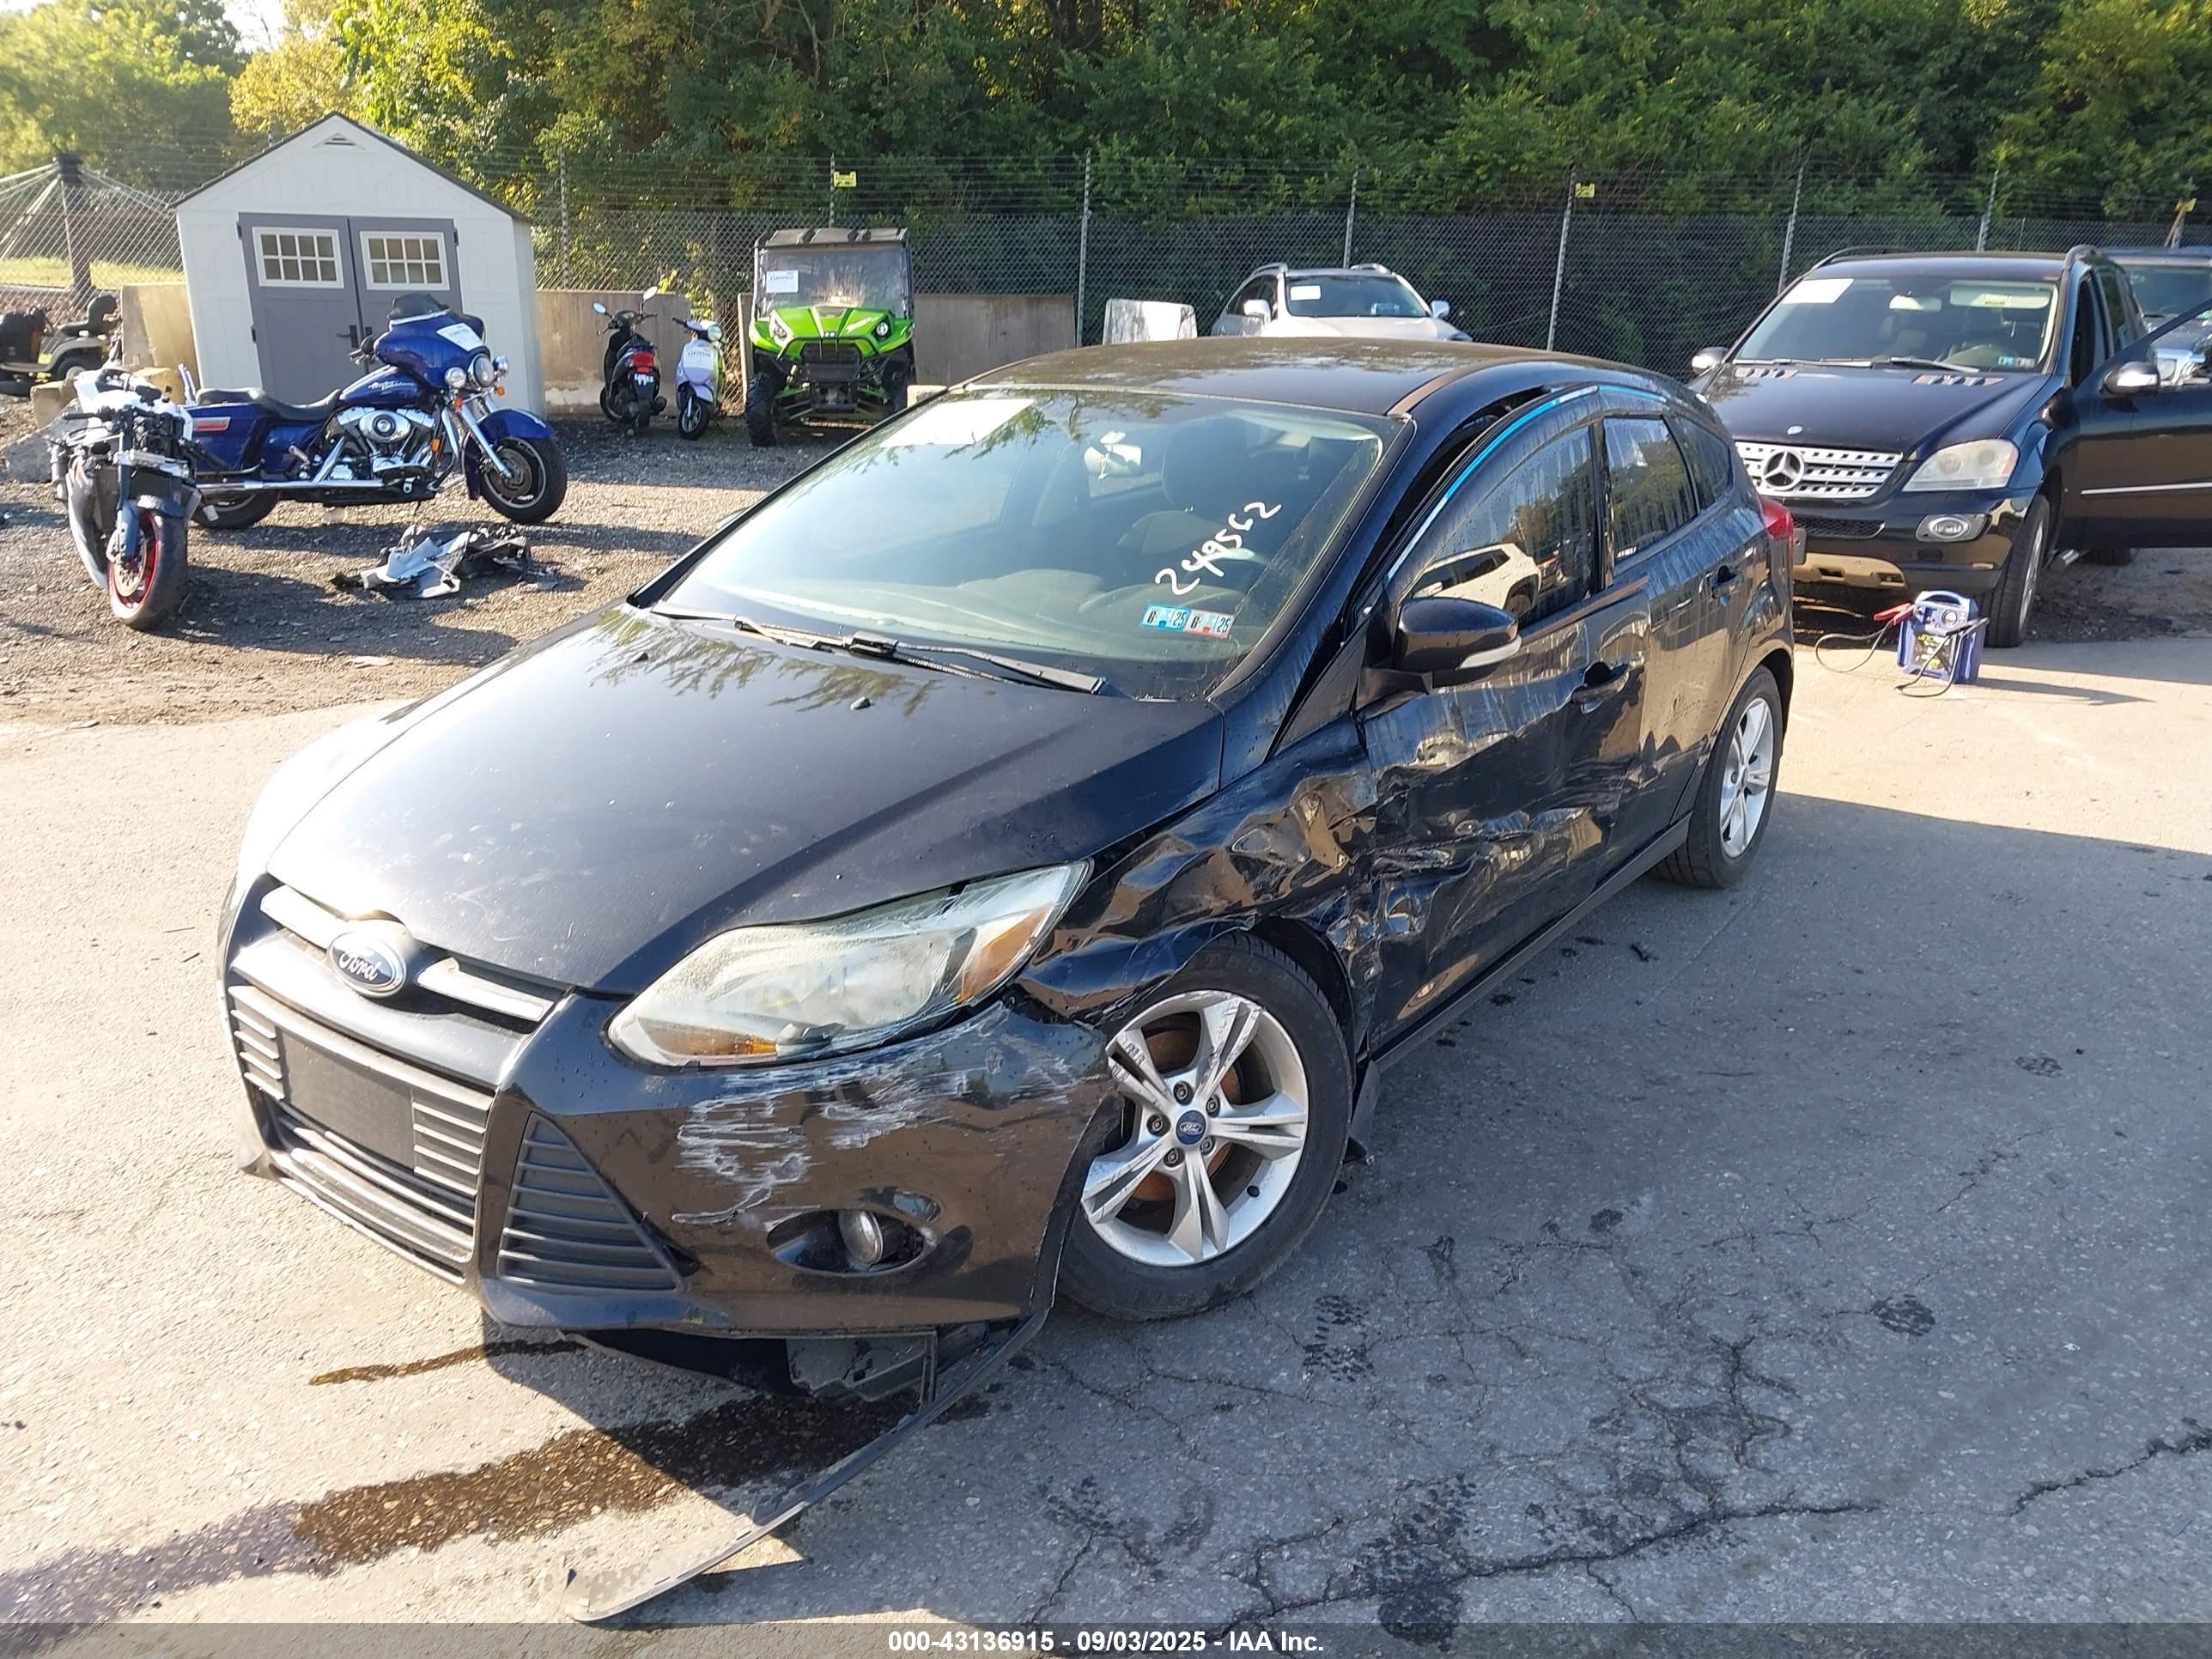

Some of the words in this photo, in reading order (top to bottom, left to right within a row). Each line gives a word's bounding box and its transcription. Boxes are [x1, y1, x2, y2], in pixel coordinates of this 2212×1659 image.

[1172, 611, 1187, 627] 25
[1216, 617, 1231, 633] 25
[338, 948, 383, 981] Ford
